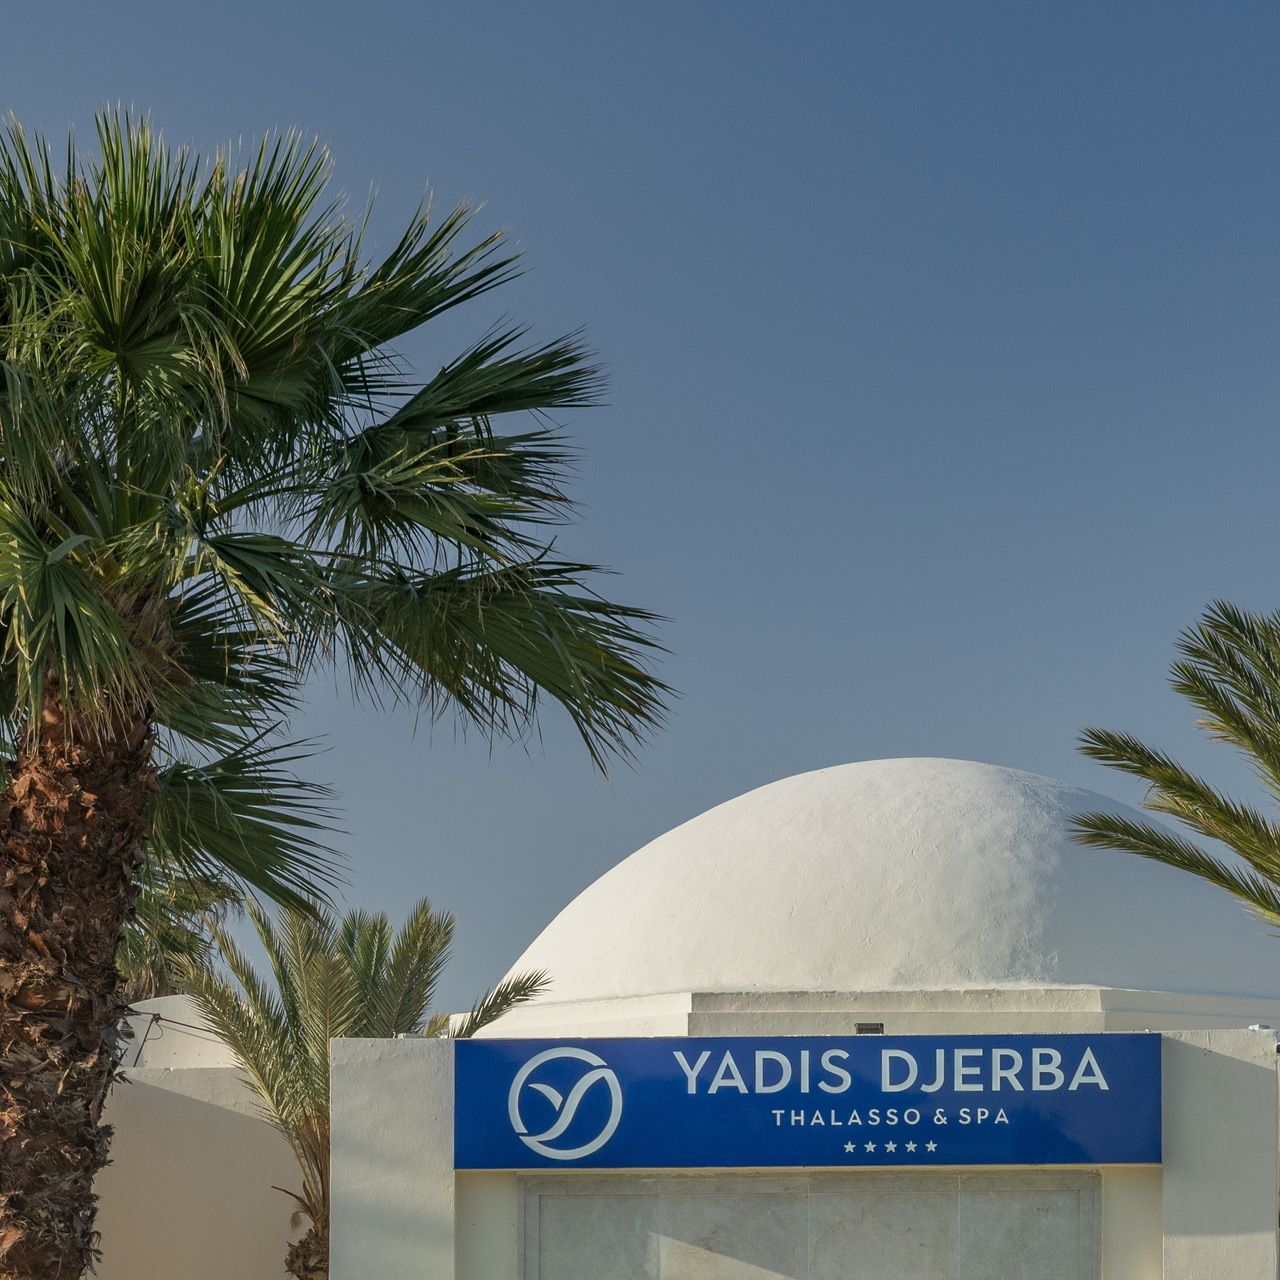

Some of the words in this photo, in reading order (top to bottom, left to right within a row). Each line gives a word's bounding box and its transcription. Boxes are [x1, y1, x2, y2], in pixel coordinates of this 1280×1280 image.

[672, 1048, 852, 1095] YADIS
[881, 1046, 1110, 1093] DJERBA
[771, 1108, 921, 1126] THALASSO
[933, 1108, 948, 1125] &
[958, 1107, 1010, 1124] SPA
